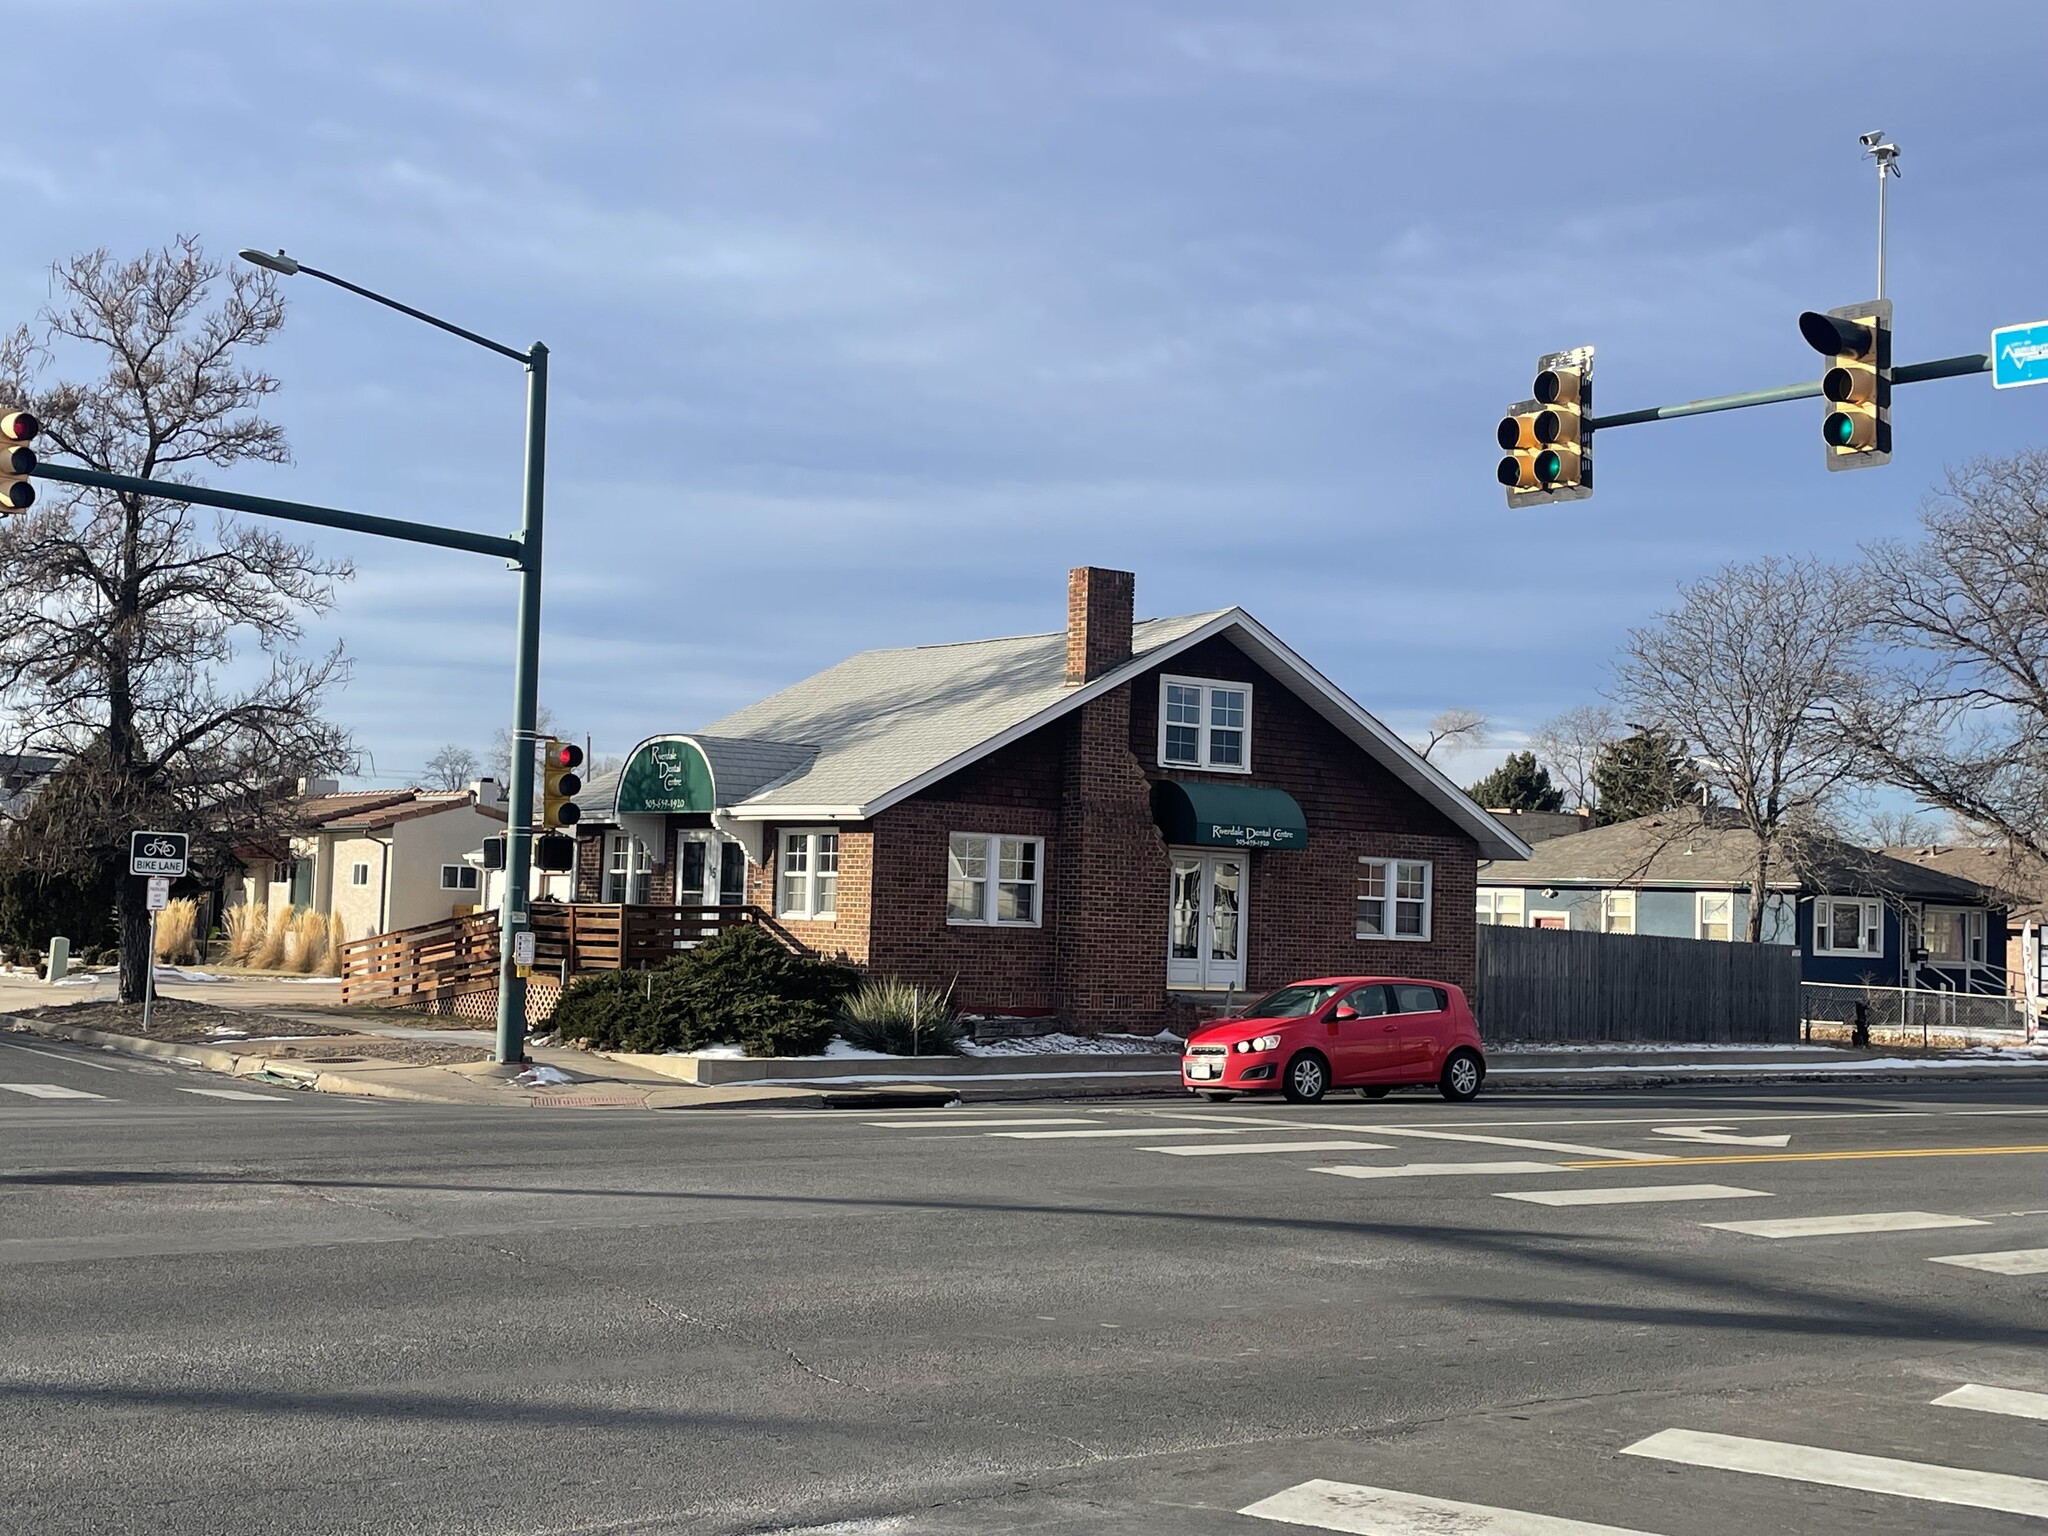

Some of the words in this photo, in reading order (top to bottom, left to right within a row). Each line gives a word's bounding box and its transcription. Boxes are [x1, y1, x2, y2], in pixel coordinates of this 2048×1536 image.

[651, 746, 677, 765] Riverdale
[659, 761, 681, 778] Dental
[664, 774, 682, 791] Centre
[1212, 825, 1244, 839] Riverdale
[1246, 827, 1271, 840] Dental
[1273, 828, 1294, 841] Centre
[136, 860, 156, 870] BIKE
[158, 861, 181, 871] LANE
